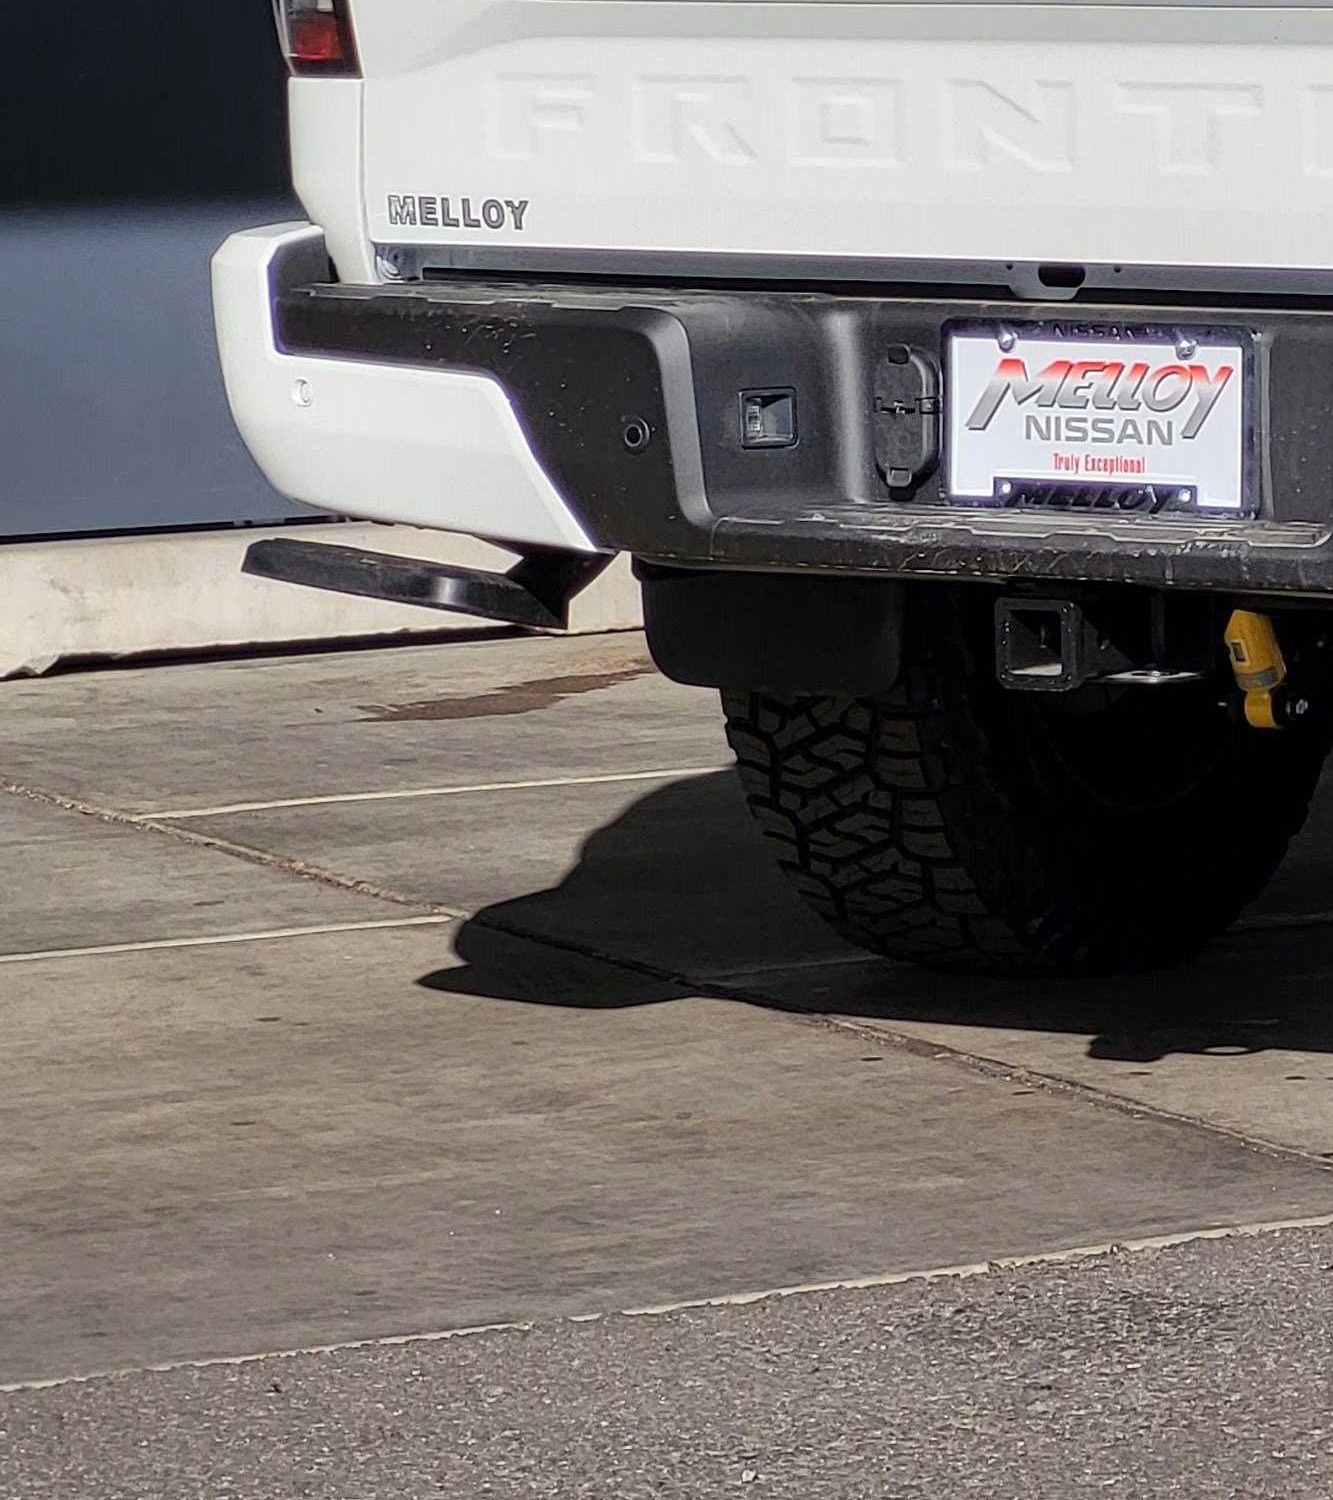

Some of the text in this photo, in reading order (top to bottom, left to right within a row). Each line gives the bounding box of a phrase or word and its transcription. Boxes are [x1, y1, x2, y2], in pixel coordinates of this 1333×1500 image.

[387, 194, 529, 231] MELLOY
[965, 357, 1234, 440] MELLOY
[1024, 414, 1174, 446] NISSAN
[1052, 451, 1146, 476] Truly Exceptional
